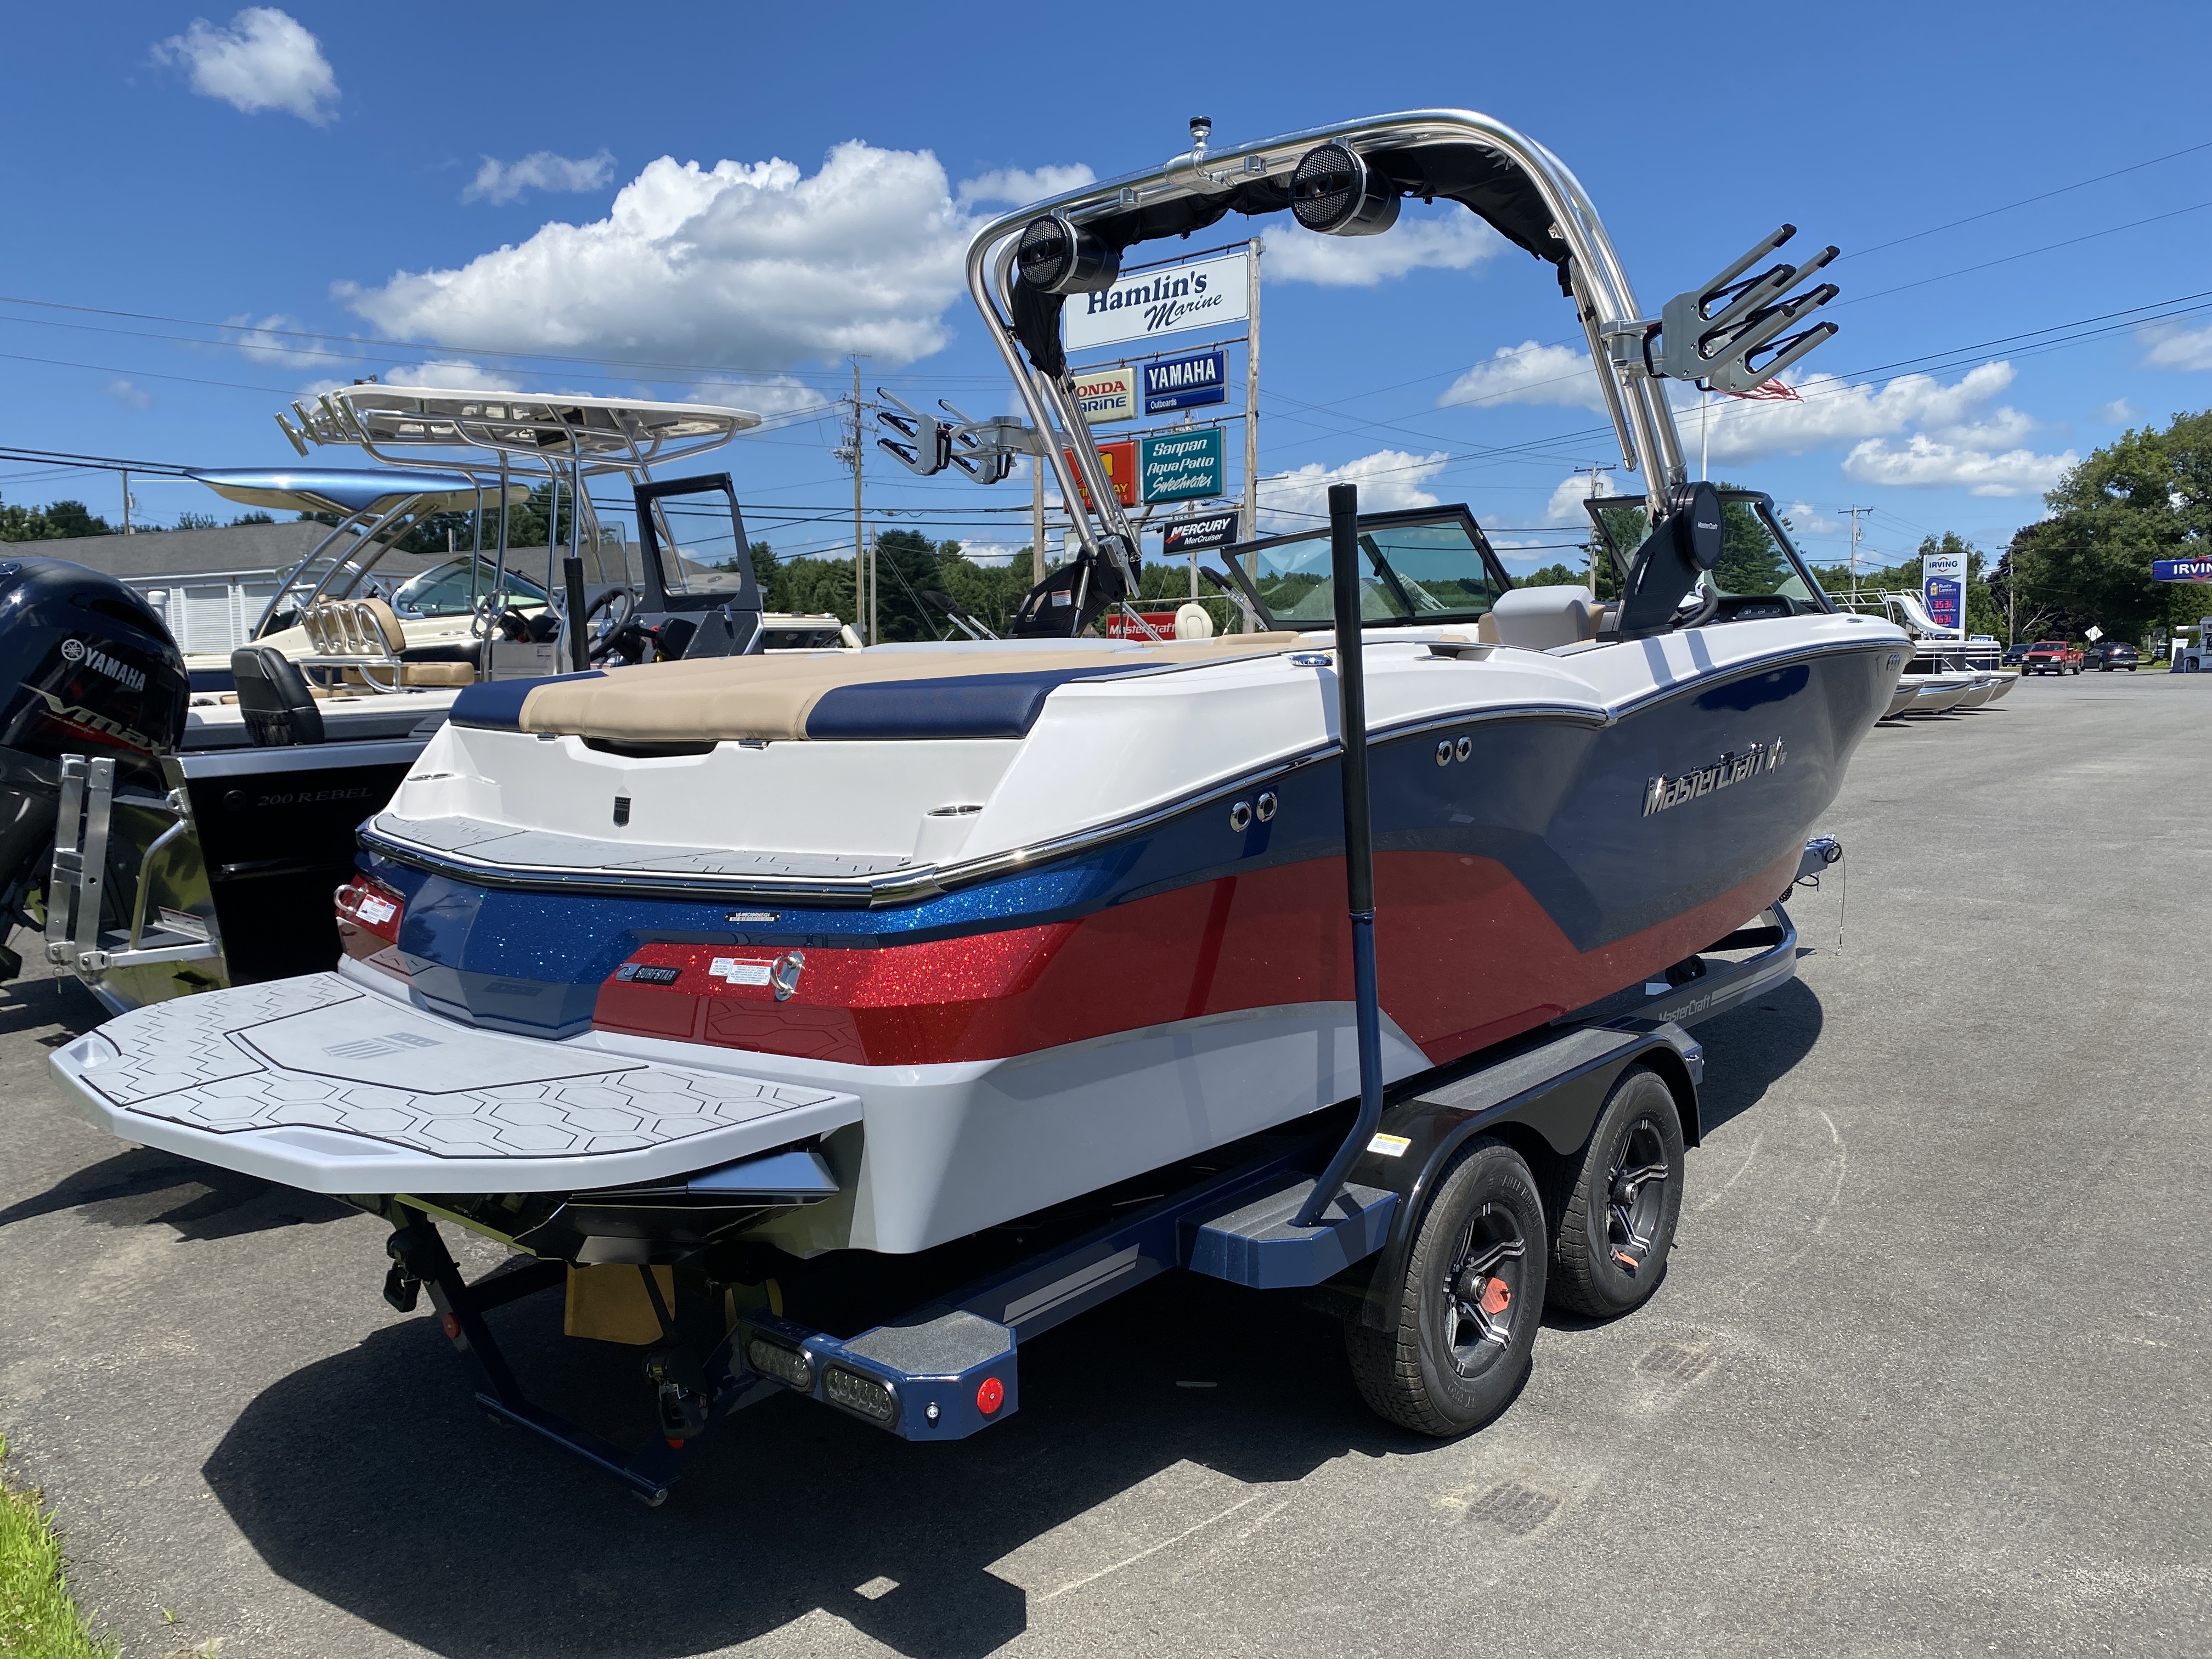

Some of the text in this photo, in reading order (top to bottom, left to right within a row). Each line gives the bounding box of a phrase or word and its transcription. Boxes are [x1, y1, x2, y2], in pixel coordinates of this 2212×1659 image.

[1087, 271, 1207, 314] Hamlin's
[1144, 294, 1223, 331] Marine
[1148, 358, 1216, 391] YAMAHA
[1076, 381, 1127, 397] ONDA
[1080, 396, 1126, 412] ARINE
[1150, 398, 1177, 409] Outboards
[1153, 439, 1207, 456] Sanpan
[1147, 457, 1214, 477] Aqua Patio
[1148, 472, 1213, 499] Sweetwater
[1170, 518, 1231, 538] MERCURY
[1184, 534, 1223, 545] MerCruiser
[2174, 563, 2212, 575] IRVIN
[84, 647, 146, 692] YAMAHA
[1641, 742, 1765, 817] MasterCraft
[257, 787, 373, 806] 200 REBEL
[636, 967, 676, 981] SURFSTAR
[1659, 994, 1711, 1022] MasterCraft
